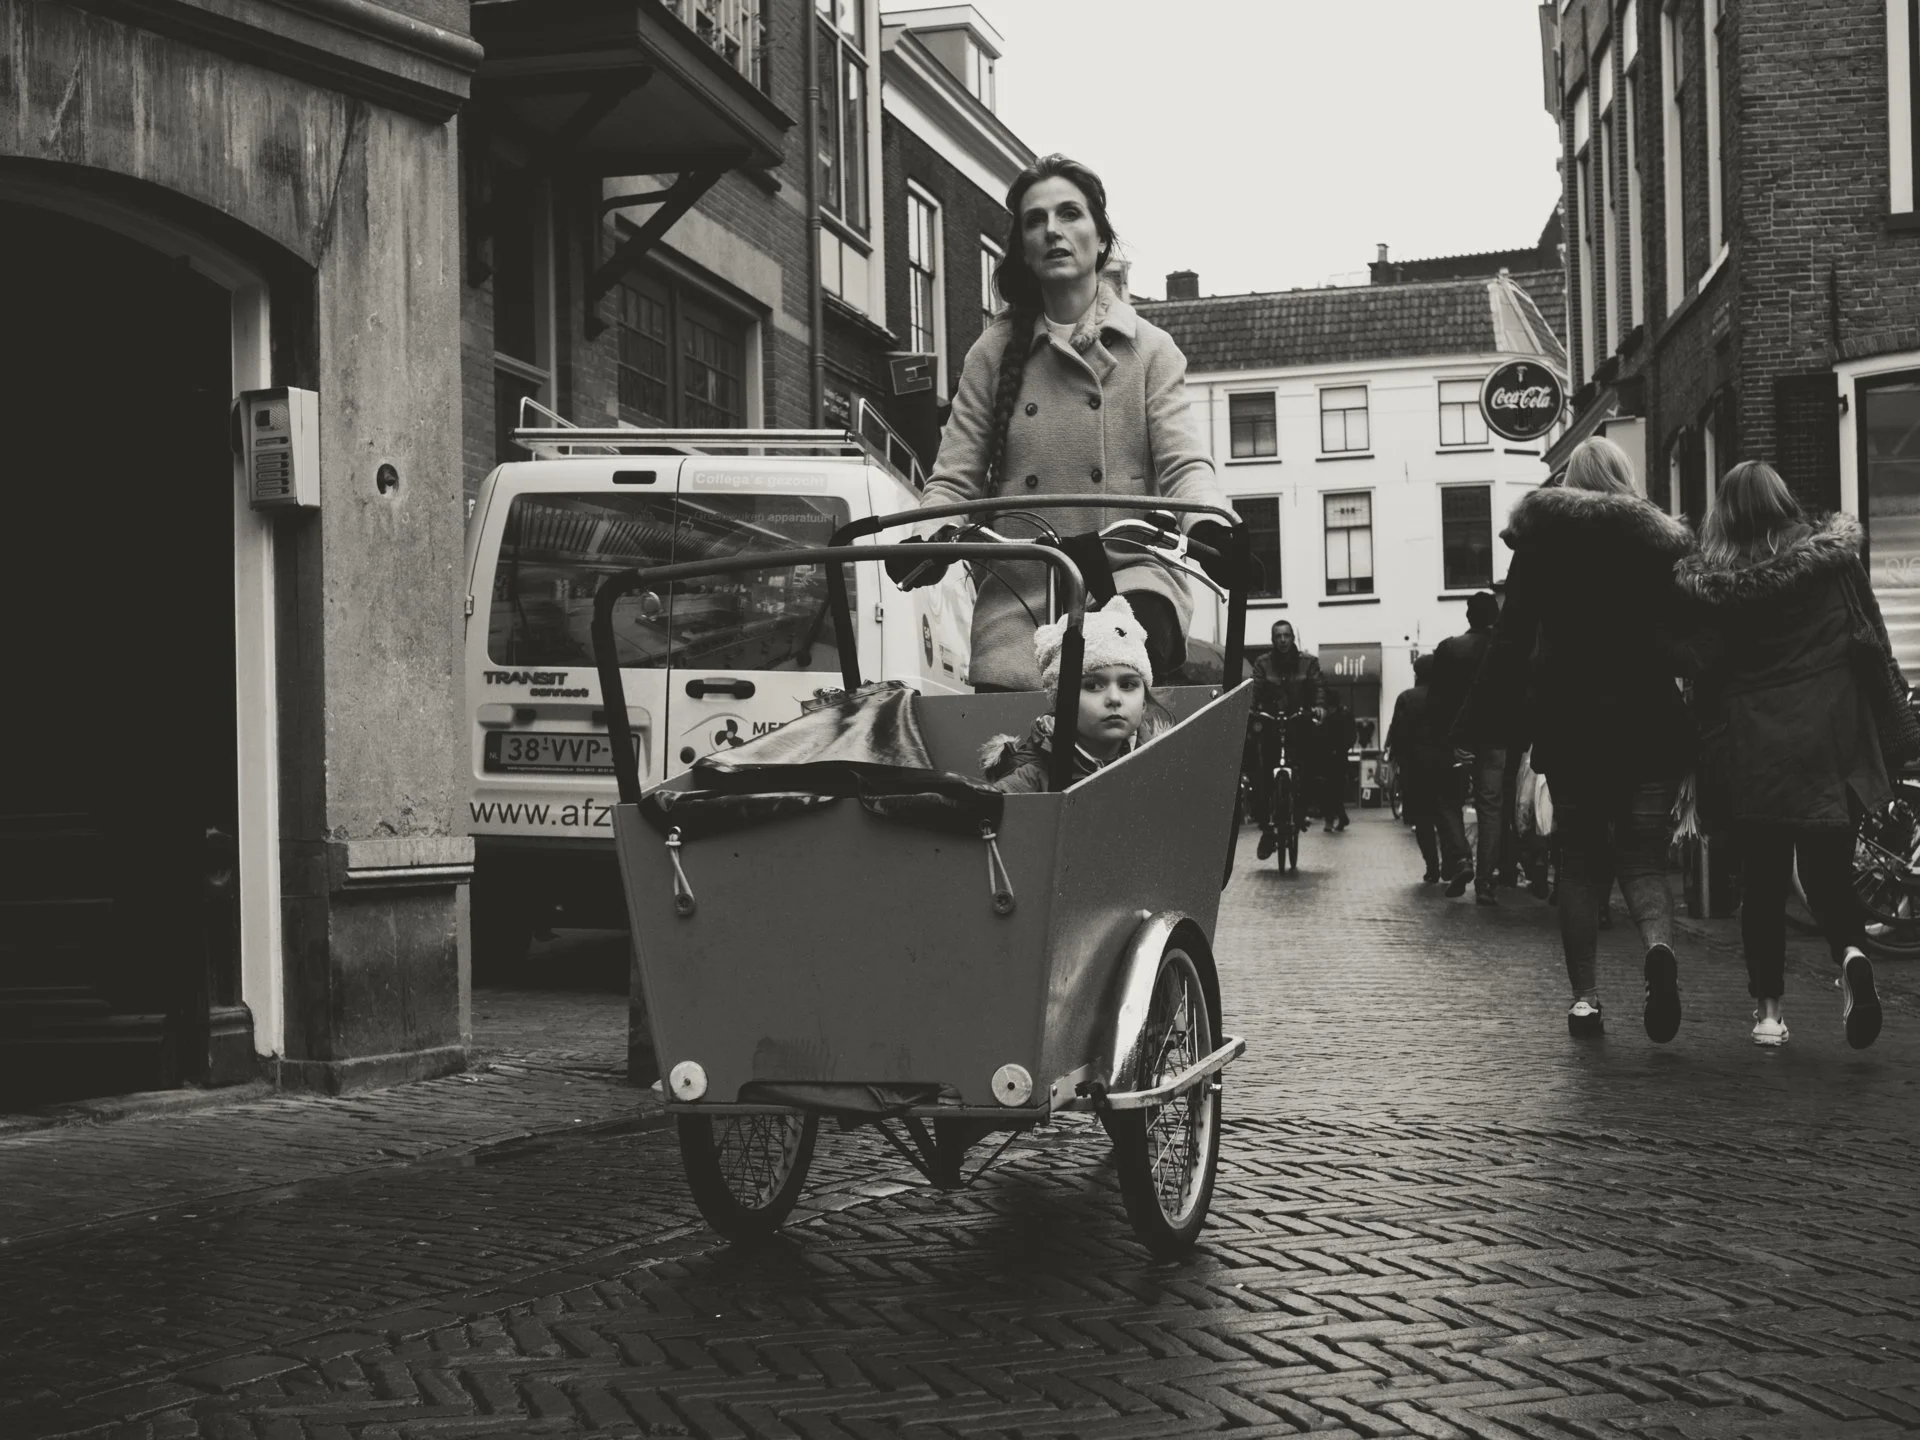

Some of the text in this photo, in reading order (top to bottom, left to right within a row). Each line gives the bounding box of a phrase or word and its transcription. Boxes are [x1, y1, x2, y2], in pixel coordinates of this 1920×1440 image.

[1491, 385, 1552, 410] Coca-Cola
[483, 671, 568, 686] TRANSIT
[1334, 654, 1366, 683] olijf
